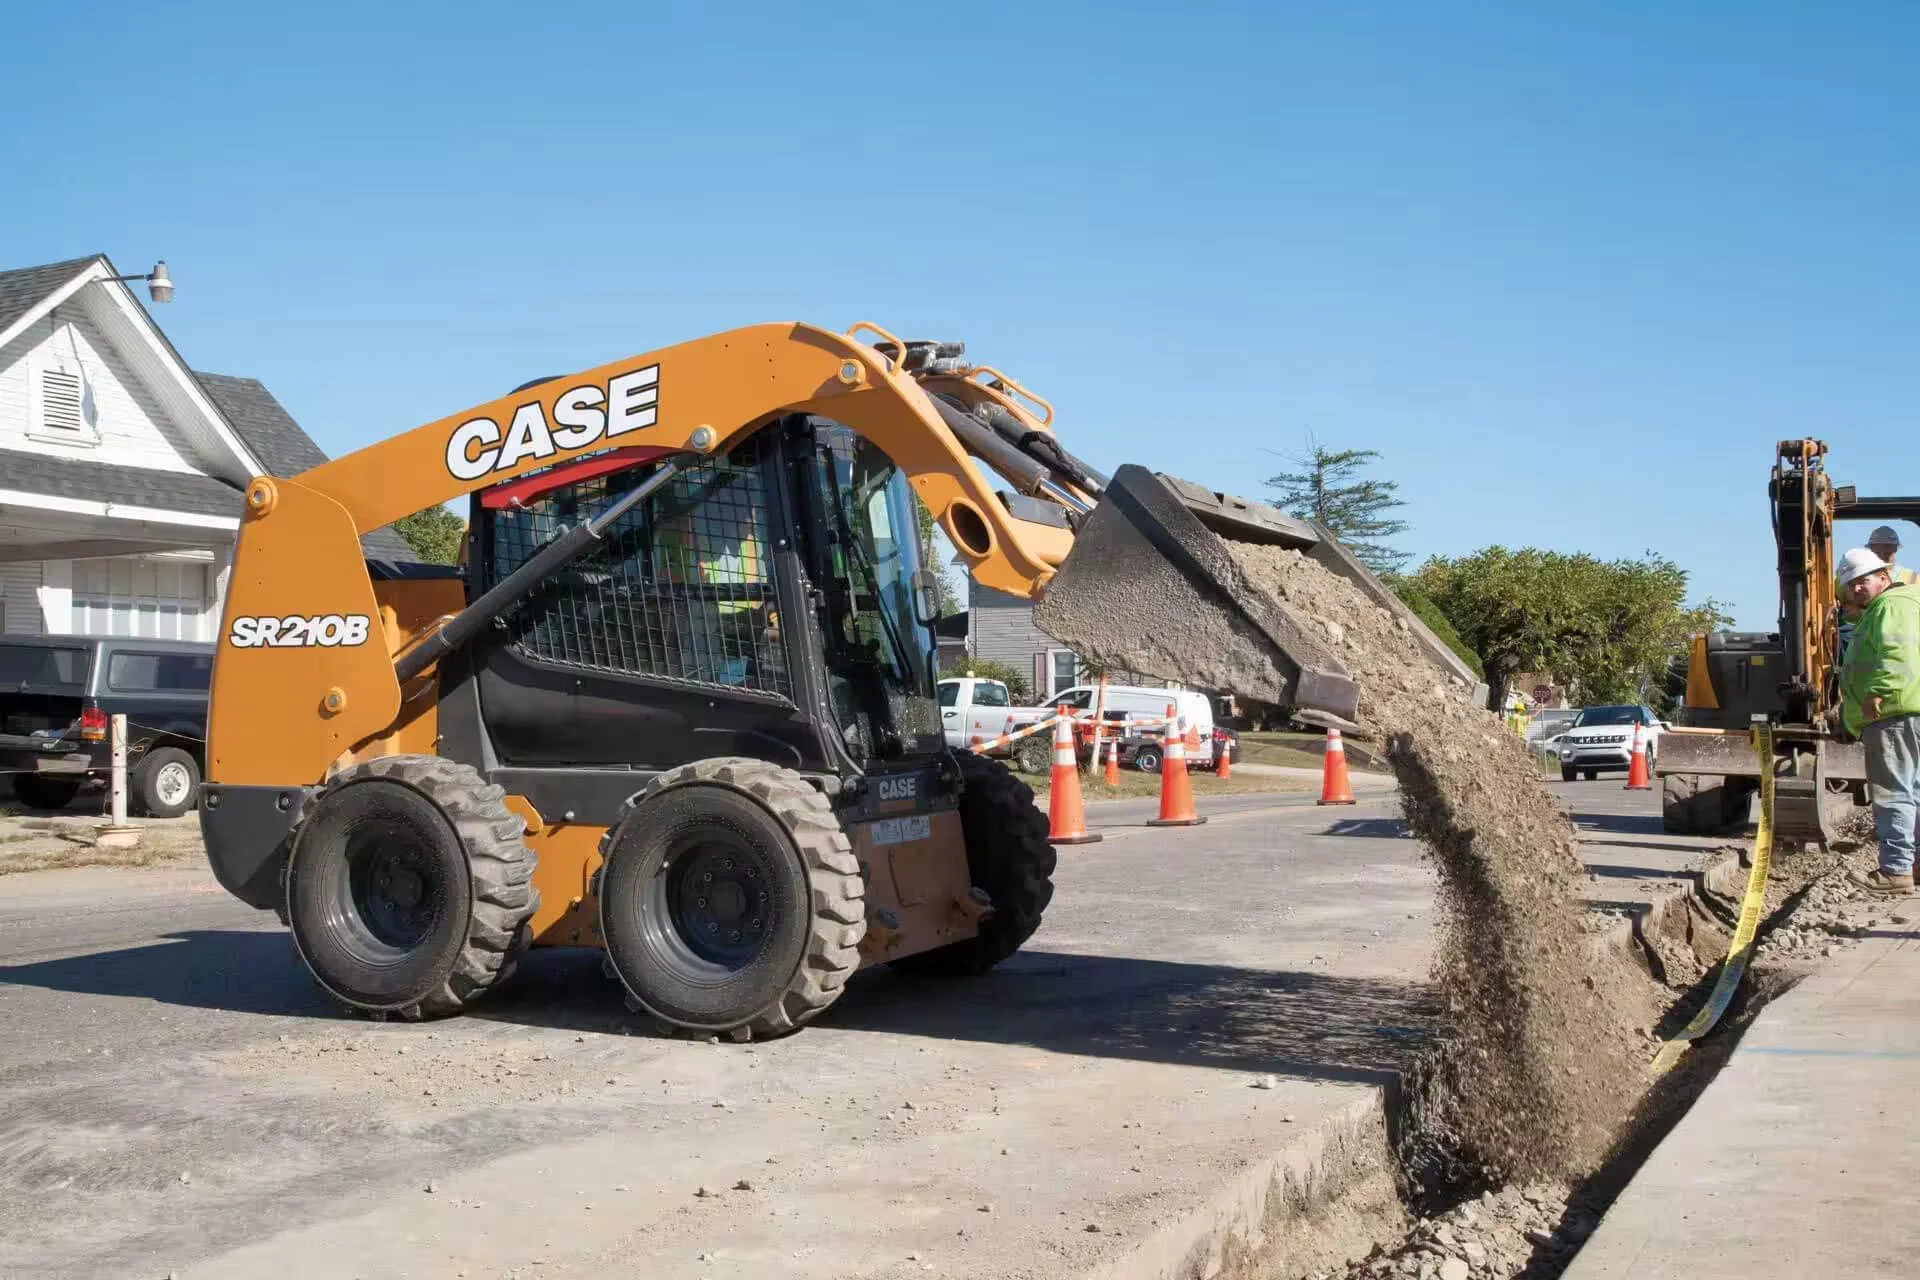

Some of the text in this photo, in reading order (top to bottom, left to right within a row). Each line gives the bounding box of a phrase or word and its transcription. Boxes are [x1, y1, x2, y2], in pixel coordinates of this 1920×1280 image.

[446, 363, 660, 480] CASE
[230, 615, 370, 648] SR210B
[879, 778, 916, 800] CASE
